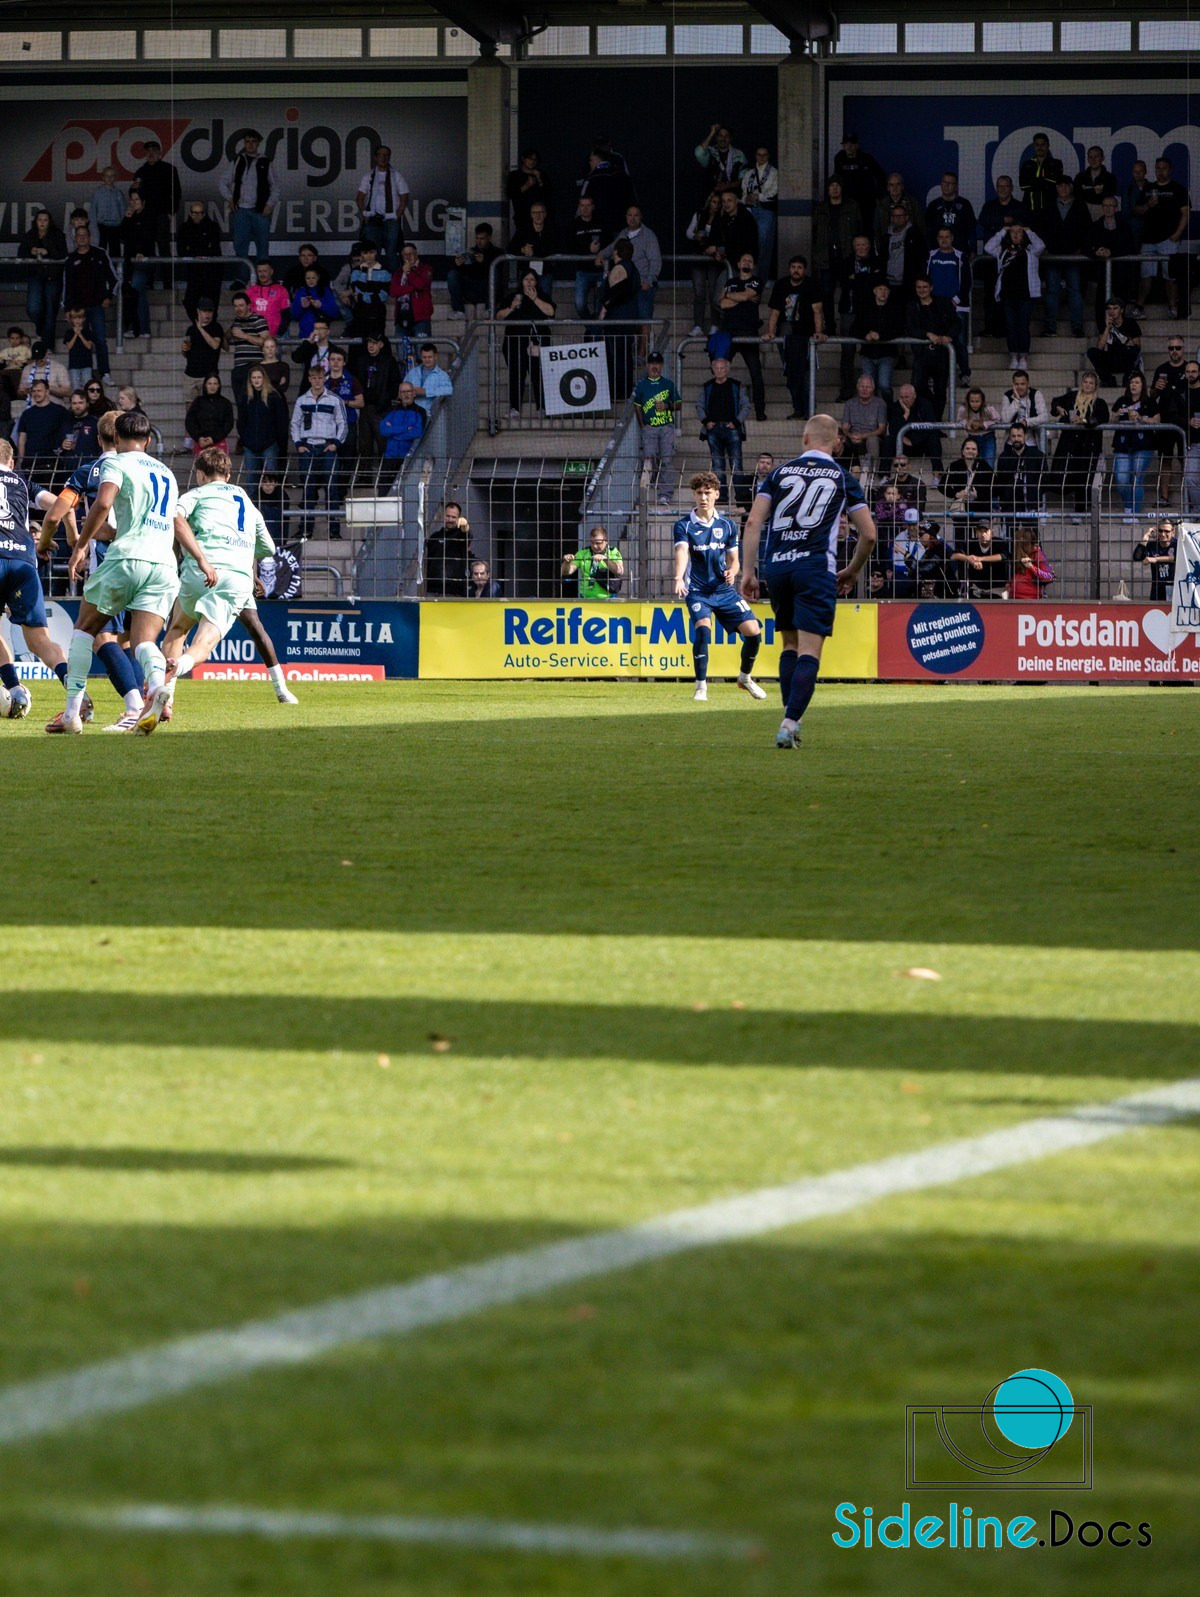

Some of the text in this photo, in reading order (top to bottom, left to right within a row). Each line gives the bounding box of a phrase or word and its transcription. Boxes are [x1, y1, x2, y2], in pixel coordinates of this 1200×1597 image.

[550, 347, 599, 361] BLOCK
[779, 466, 841, 479] BABELSBERG
[772, 475, 838, 531] 20
[232, 495, 245, 532] 7
[781, 530, 809, 541] HASSE
[771, 549, 811, 563] Katjes
[287, 621, 394, 643] THALIA
[913, 611, 971, 634] Mit regionaler
[1018, 613, 1139, 647] Potsdam
[911, 624, 981, 649] Energie punkten.
[287, 647, 361, 657] DAS PROGRAMMKINO
[922, 640, 977, 663] potsdam-liebe.de
[504, 653, 690, 672] Auto-Service. Echt gut.
[1018, 657, 1054, 672] Deine
[1056, 657, 1106, 674] Energie.
[1109, 657, 1141, 673] Deine
[1144, 657, 1179, 673] Stadt.
